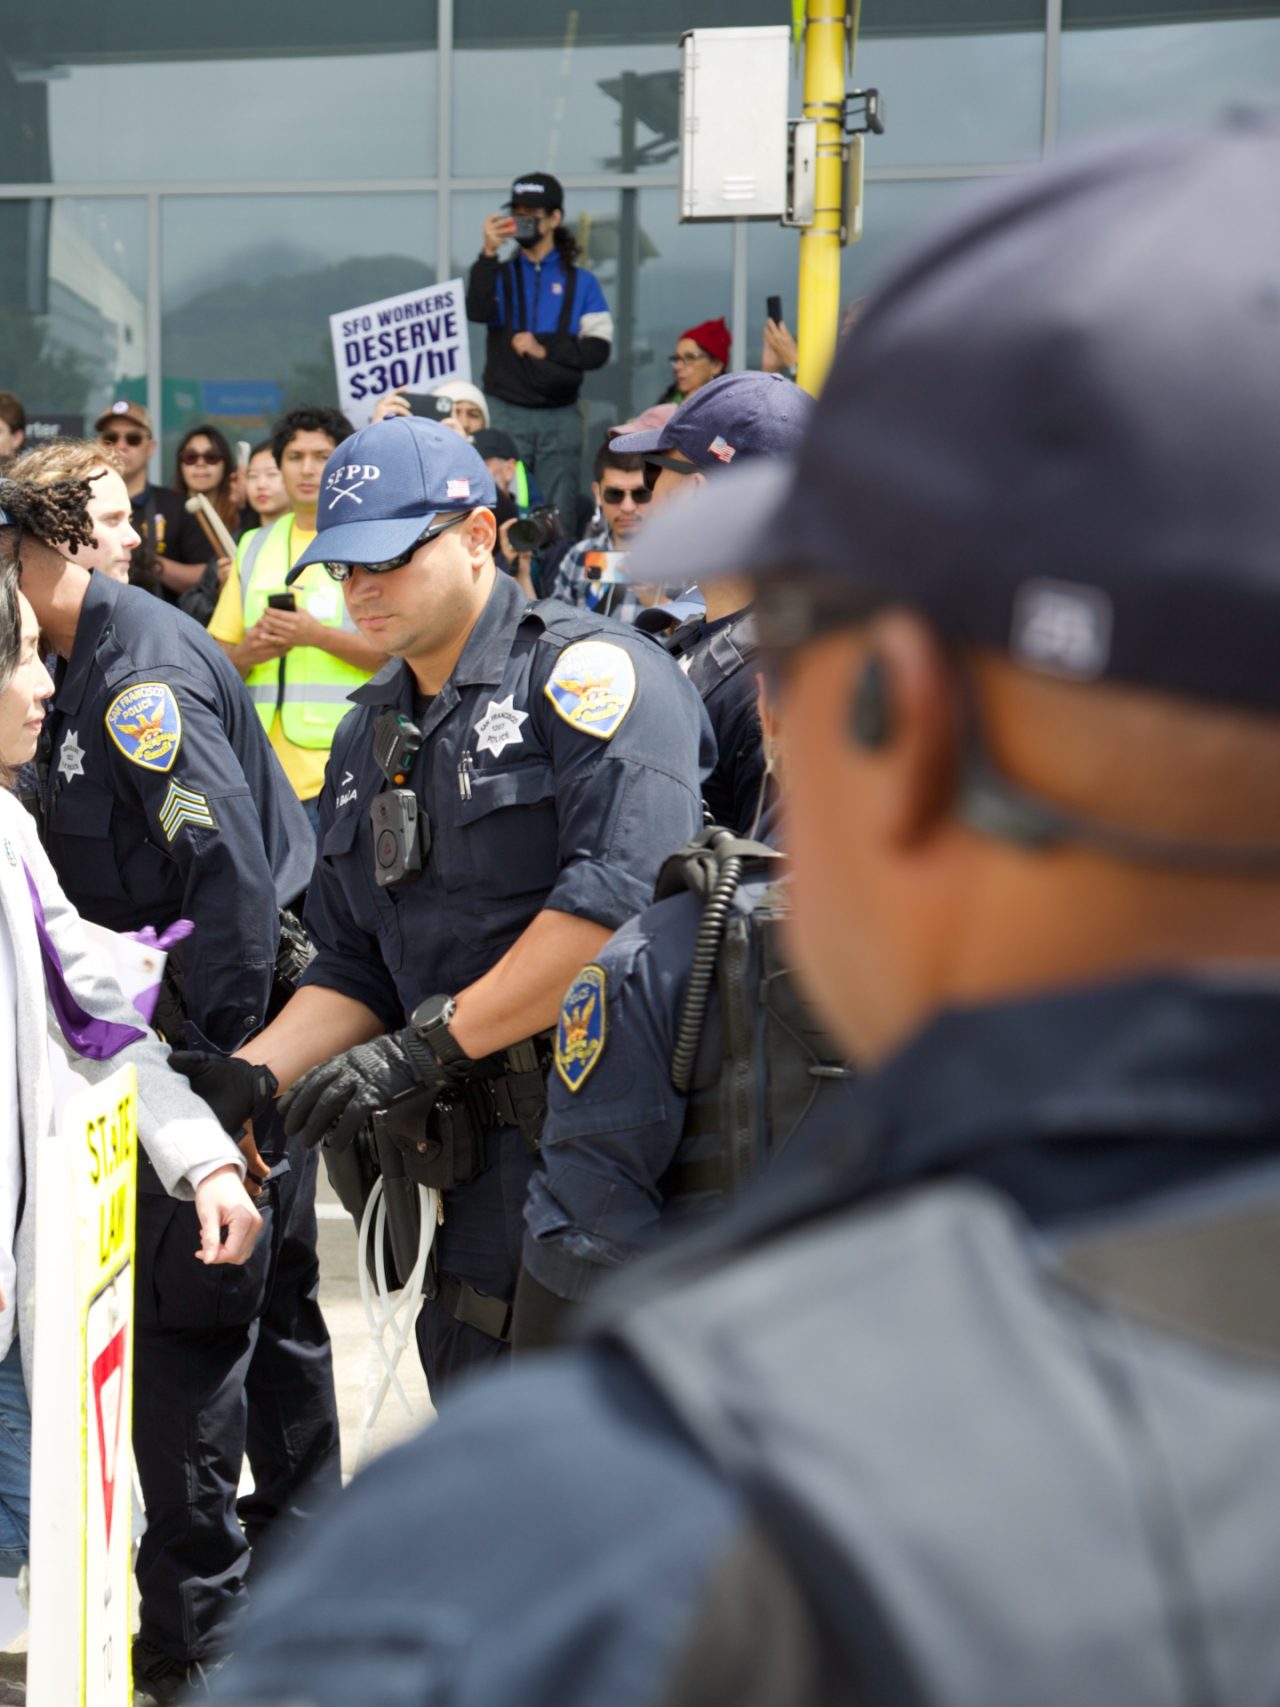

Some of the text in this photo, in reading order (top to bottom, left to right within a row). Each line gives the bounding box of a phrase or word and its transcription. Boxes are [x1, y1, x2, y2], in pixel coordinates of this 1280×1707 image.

[342, 291, 455, 337] SFO WORKERS
[345, 311, 458, 367] DESERVE
[349, 345, 459, 400] $30/hr
[25, 421, 60, 436] rter
[325, 464, 380, 490] SFPD
[109, 687, 165, 724] SAN FRANCISCO
[122, 698, 154, 720] POLICE
[87, 1094, 130, 1185] STATE
[100, 1182, 127, 1267] LAW
